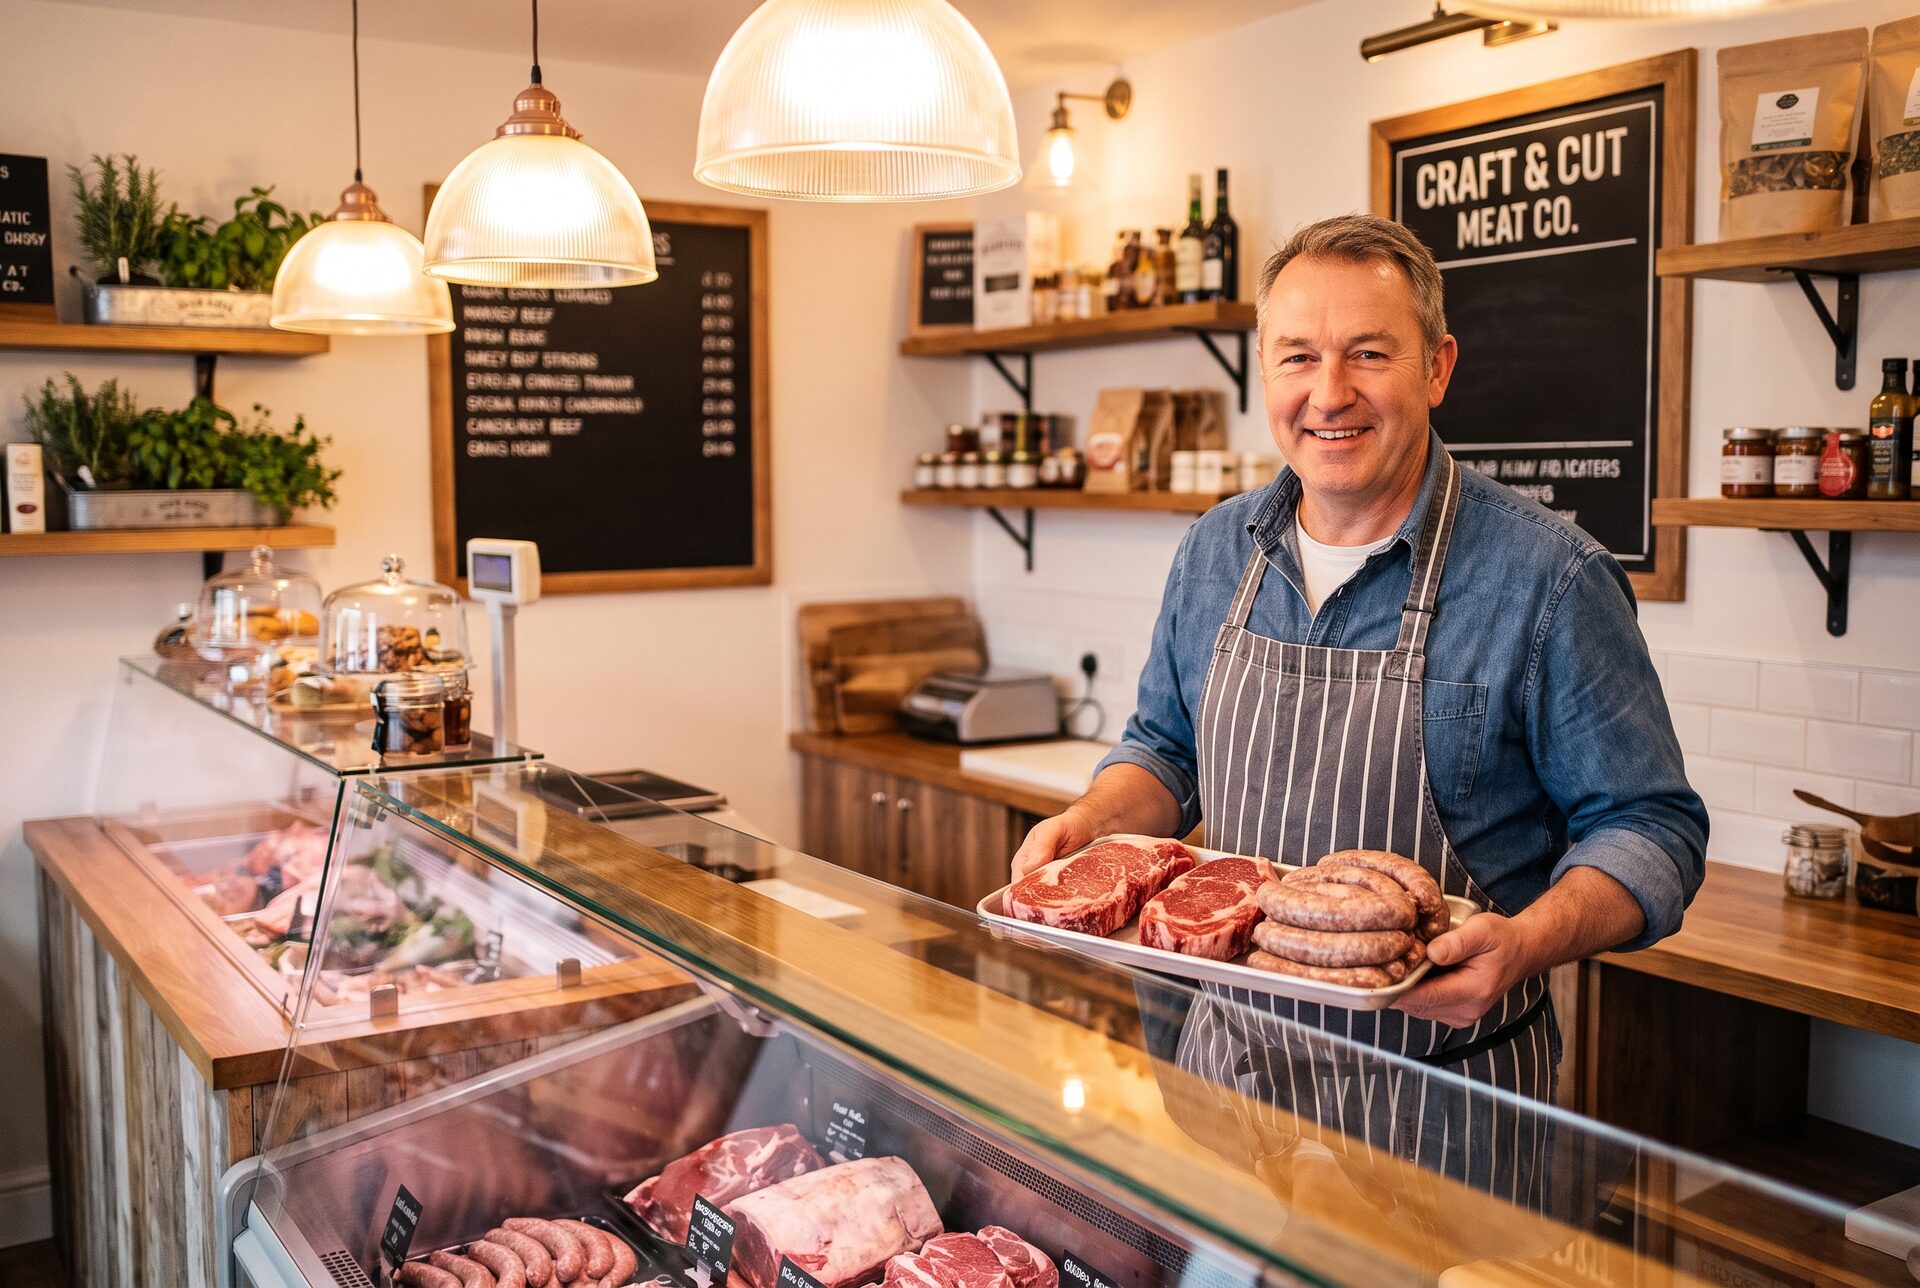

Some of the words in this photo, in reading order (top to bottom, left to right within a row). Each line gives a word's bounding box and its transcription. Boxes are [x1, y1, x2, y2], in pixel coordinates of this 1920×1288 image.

[1416, 147, 1518, 210] CRAFT
[1524, 141, 1551, 192] &
[1557, 126, 1629, 186] CUT
[1457, 201, 1529, 250] MEAT
[1532, 195, 1580, 240] CO.
